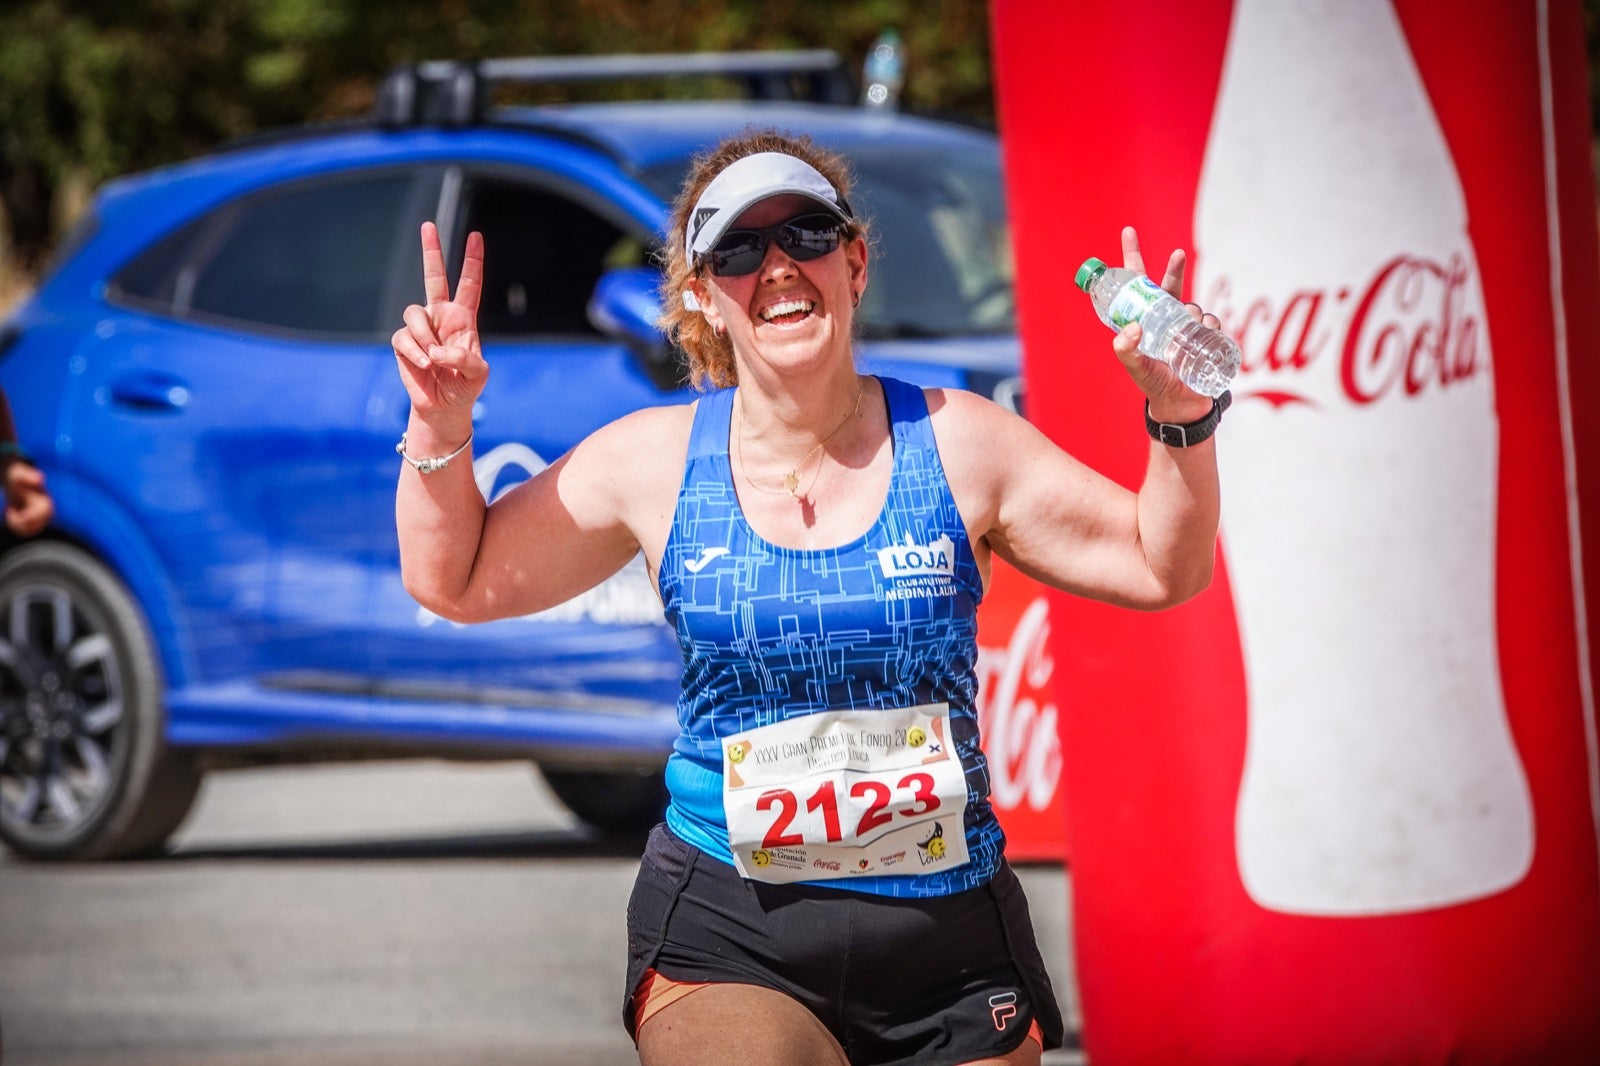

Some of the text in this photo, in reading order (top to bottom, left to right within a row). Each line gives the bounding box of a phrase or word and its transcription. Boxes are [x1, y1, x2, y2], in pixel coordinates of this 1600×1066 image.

[1206, 252, 1479, 405] ca-Cola
[891, 551, 949, 571] LOJA
[896, 578, 918, 588] CLUB
[754, 745, 779, 766] XXXV
[782, 742, 808, 759] GRAN
[860, 730, 892, 748] FONDO
[755, 772, 941, 849] 2123
[777, 851, 807, 863] Granada
